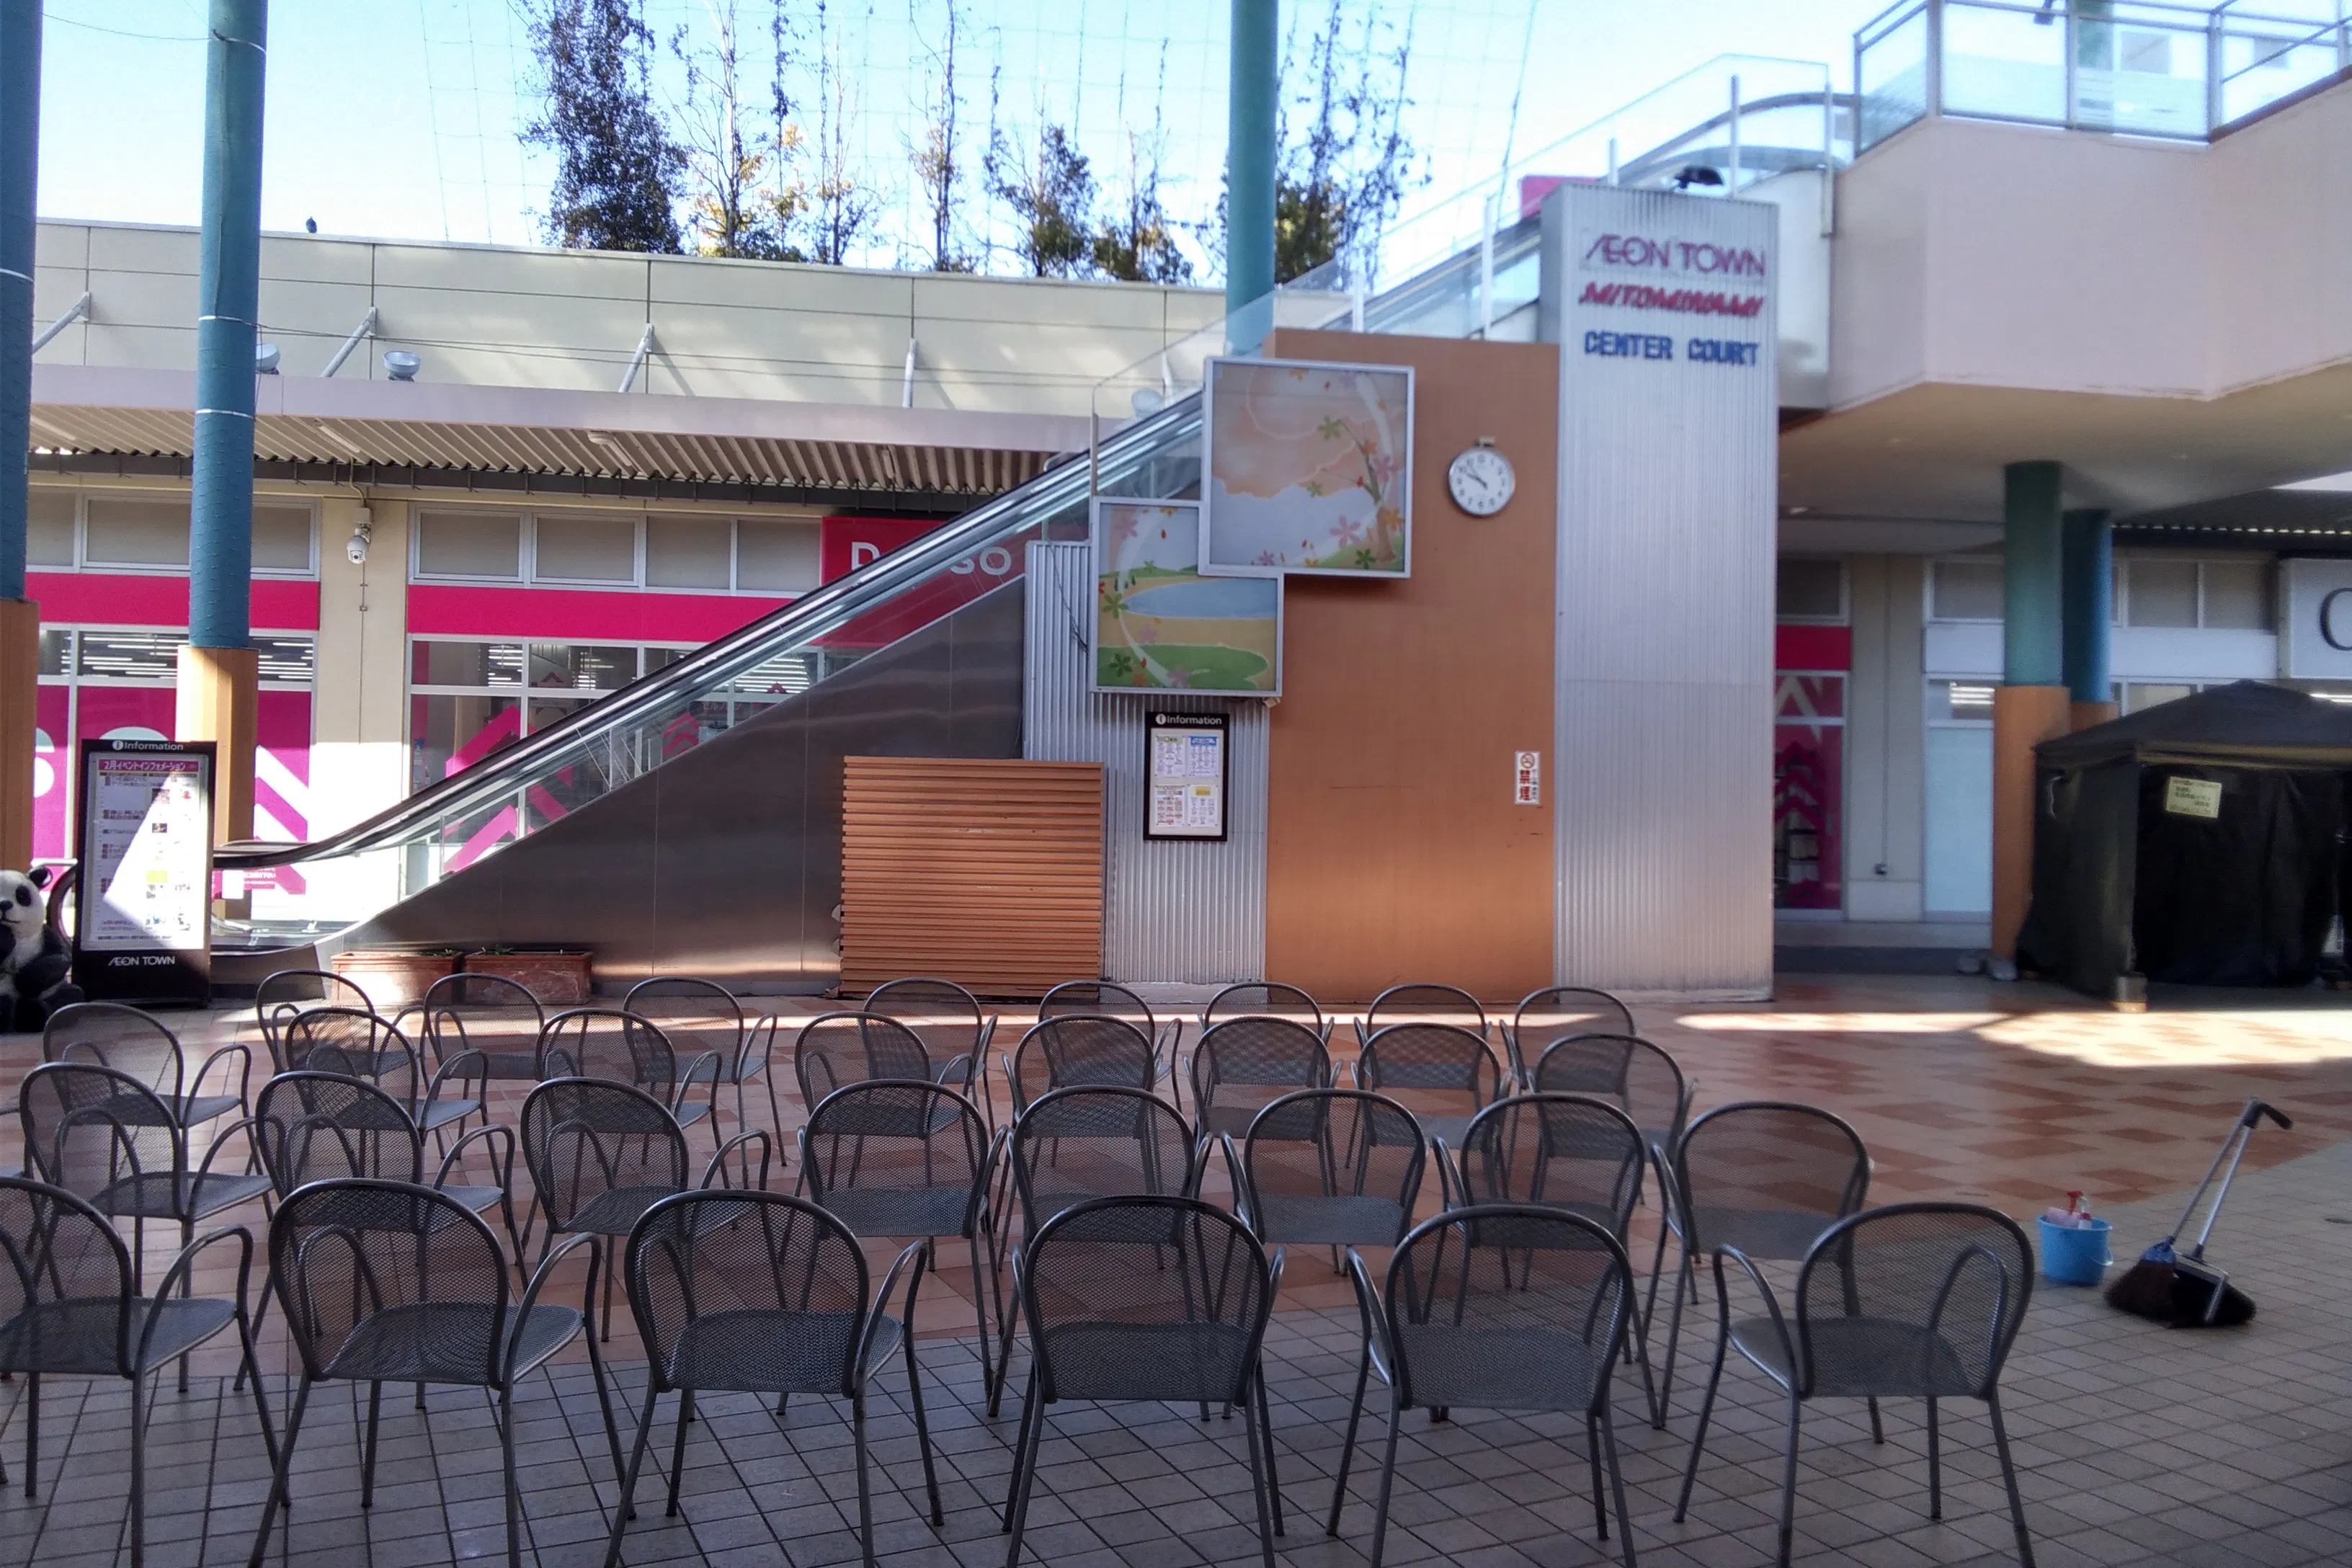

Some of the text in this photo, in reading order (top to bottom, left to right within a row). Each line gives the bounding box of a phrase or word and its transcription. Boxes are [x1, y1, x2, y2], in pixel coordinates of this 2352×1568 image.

[1678, 241, 1765, 277] TOWN
[1584, 329, 1760, 368] CENTER COURT
[1167, 714, 1222, 725] Information
[124, 741, 184, 751] Information
[142, 956, 176, 966] TOWN
